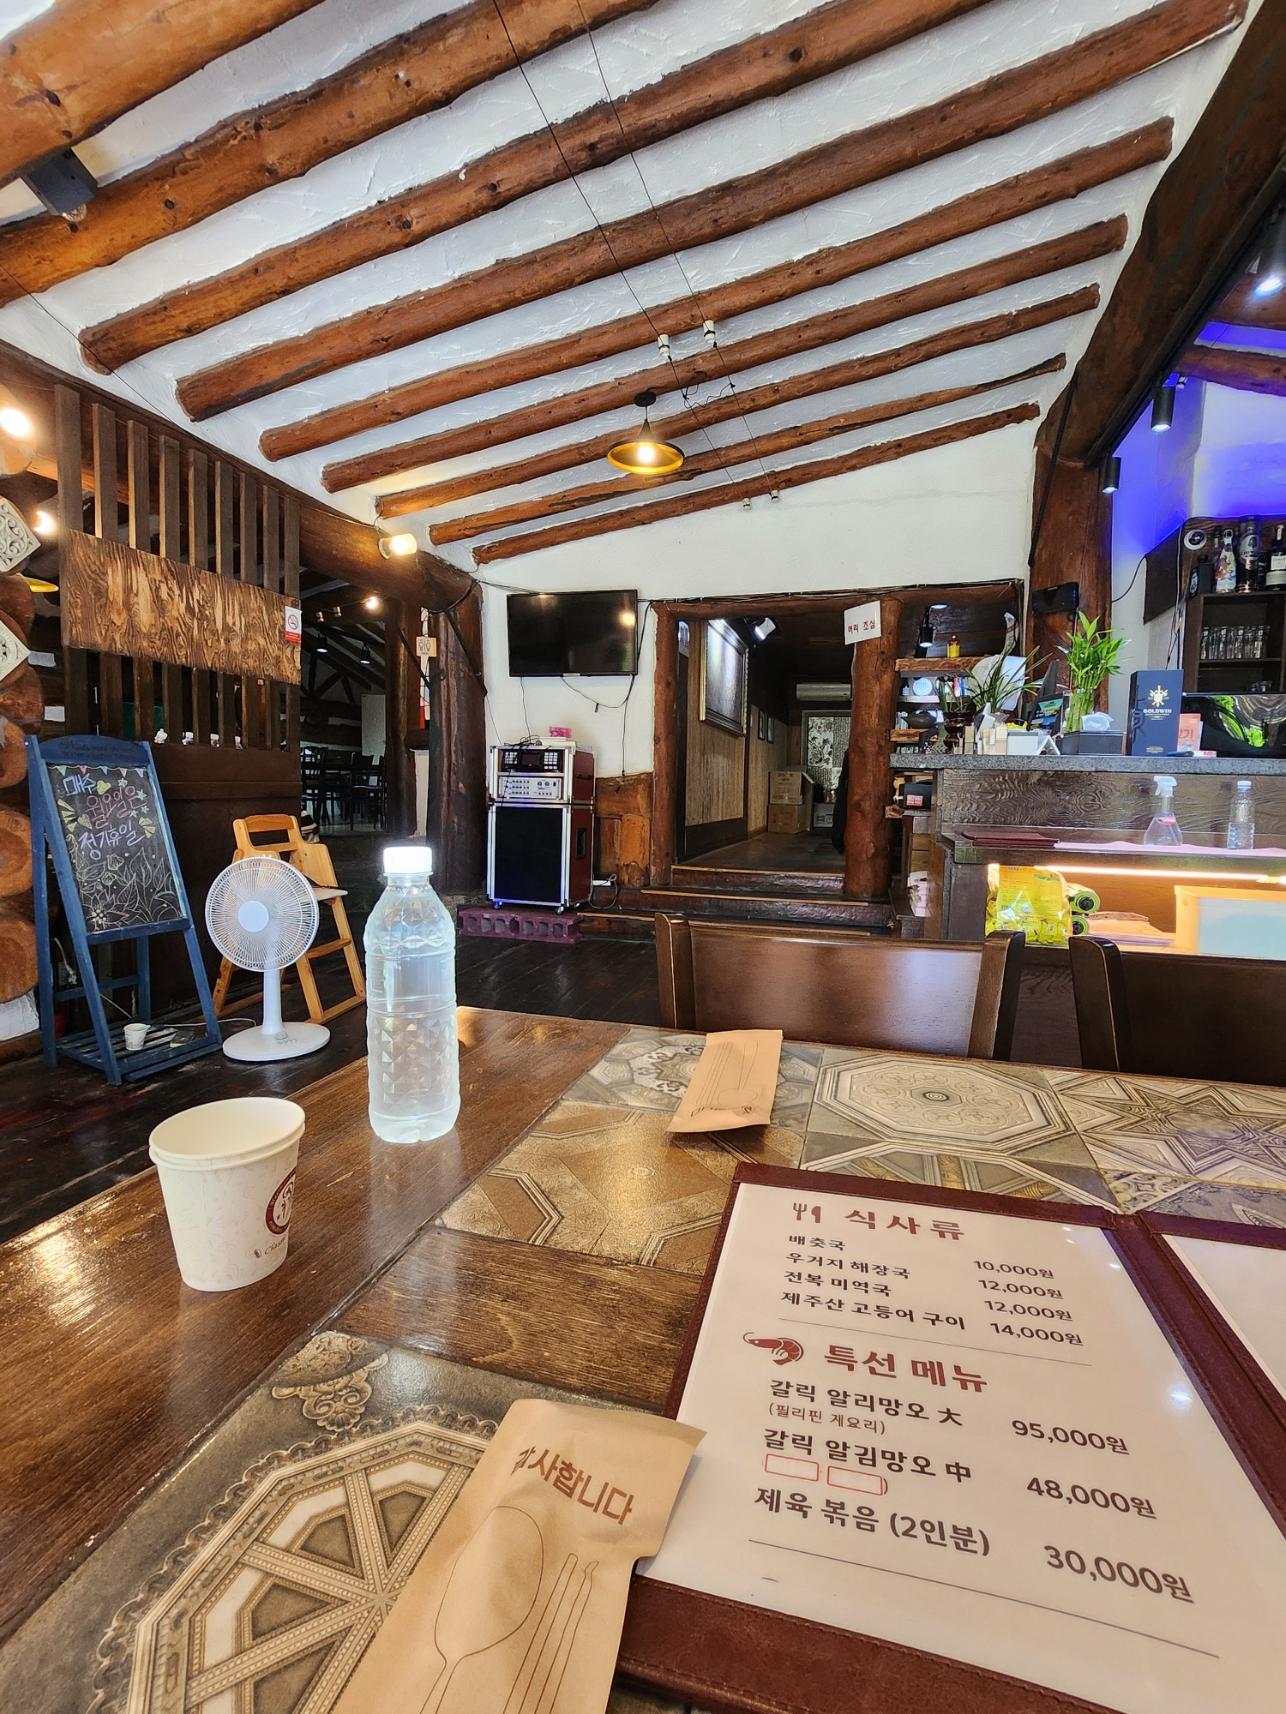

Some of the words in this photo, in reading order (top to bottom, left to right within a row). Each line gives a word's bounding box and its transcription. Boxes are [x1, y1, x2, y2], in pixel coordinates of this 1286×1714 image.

[863, 618, 876, 631] 조심
[63, 773, 97, 796] 매주
[85, 785, 147, 829] 월요일은
[78, 819, 145, 861] 정기휴일
[787, 1234, 847, 1252] 배춧국
[785, 1251, 844, 1271] 우거지
[850, 1260, 911, 1280] 해장국
[973, 1259, 1055, 1280] 10,000원
[784, 1270, 824, 1288] 전복
[831, 1277, 892, 1298] 미역국
[978, 1279, 1064, 1300] 12,000원
[780, 1291, 845, 1312] 제주산
[851, 1302, 915, 1324] 고등어
[922, 1311, 966, 1331] 구이
[983, 1299, 1073, 1322] 12,000원
[990, 1322, 1084, 1347] 14,000원
[824, 1344, 898, 1380] 특선
[911, 1357, 989, 1394] 메뉴
[768, 1401, 823, 1425] (필리핀
[829, 1411, 887, 1436] 게요리)
[769, 1379, 817, 1404] 갈릭
[826, 1388, 931, 1422] 알리망오
[936, 1407, 964, 1427] 大
[1011, 1418, 1130, 1456] 95,000원
[763, 1427, 814, 1456] 갈릭
[824, 1438, 937, 1476] 알김망오
[944, 1460, 973, 1484] 中
[1026, 1475, 1158, 1520] 48,000원
[753, 1486, 813, 1519] 제육
[821, 1497, 880, 1534] 볶음
[889, 1510, 991, 1557] (2인분)
[1043, 1544, 1195, 1604] 30,000원
